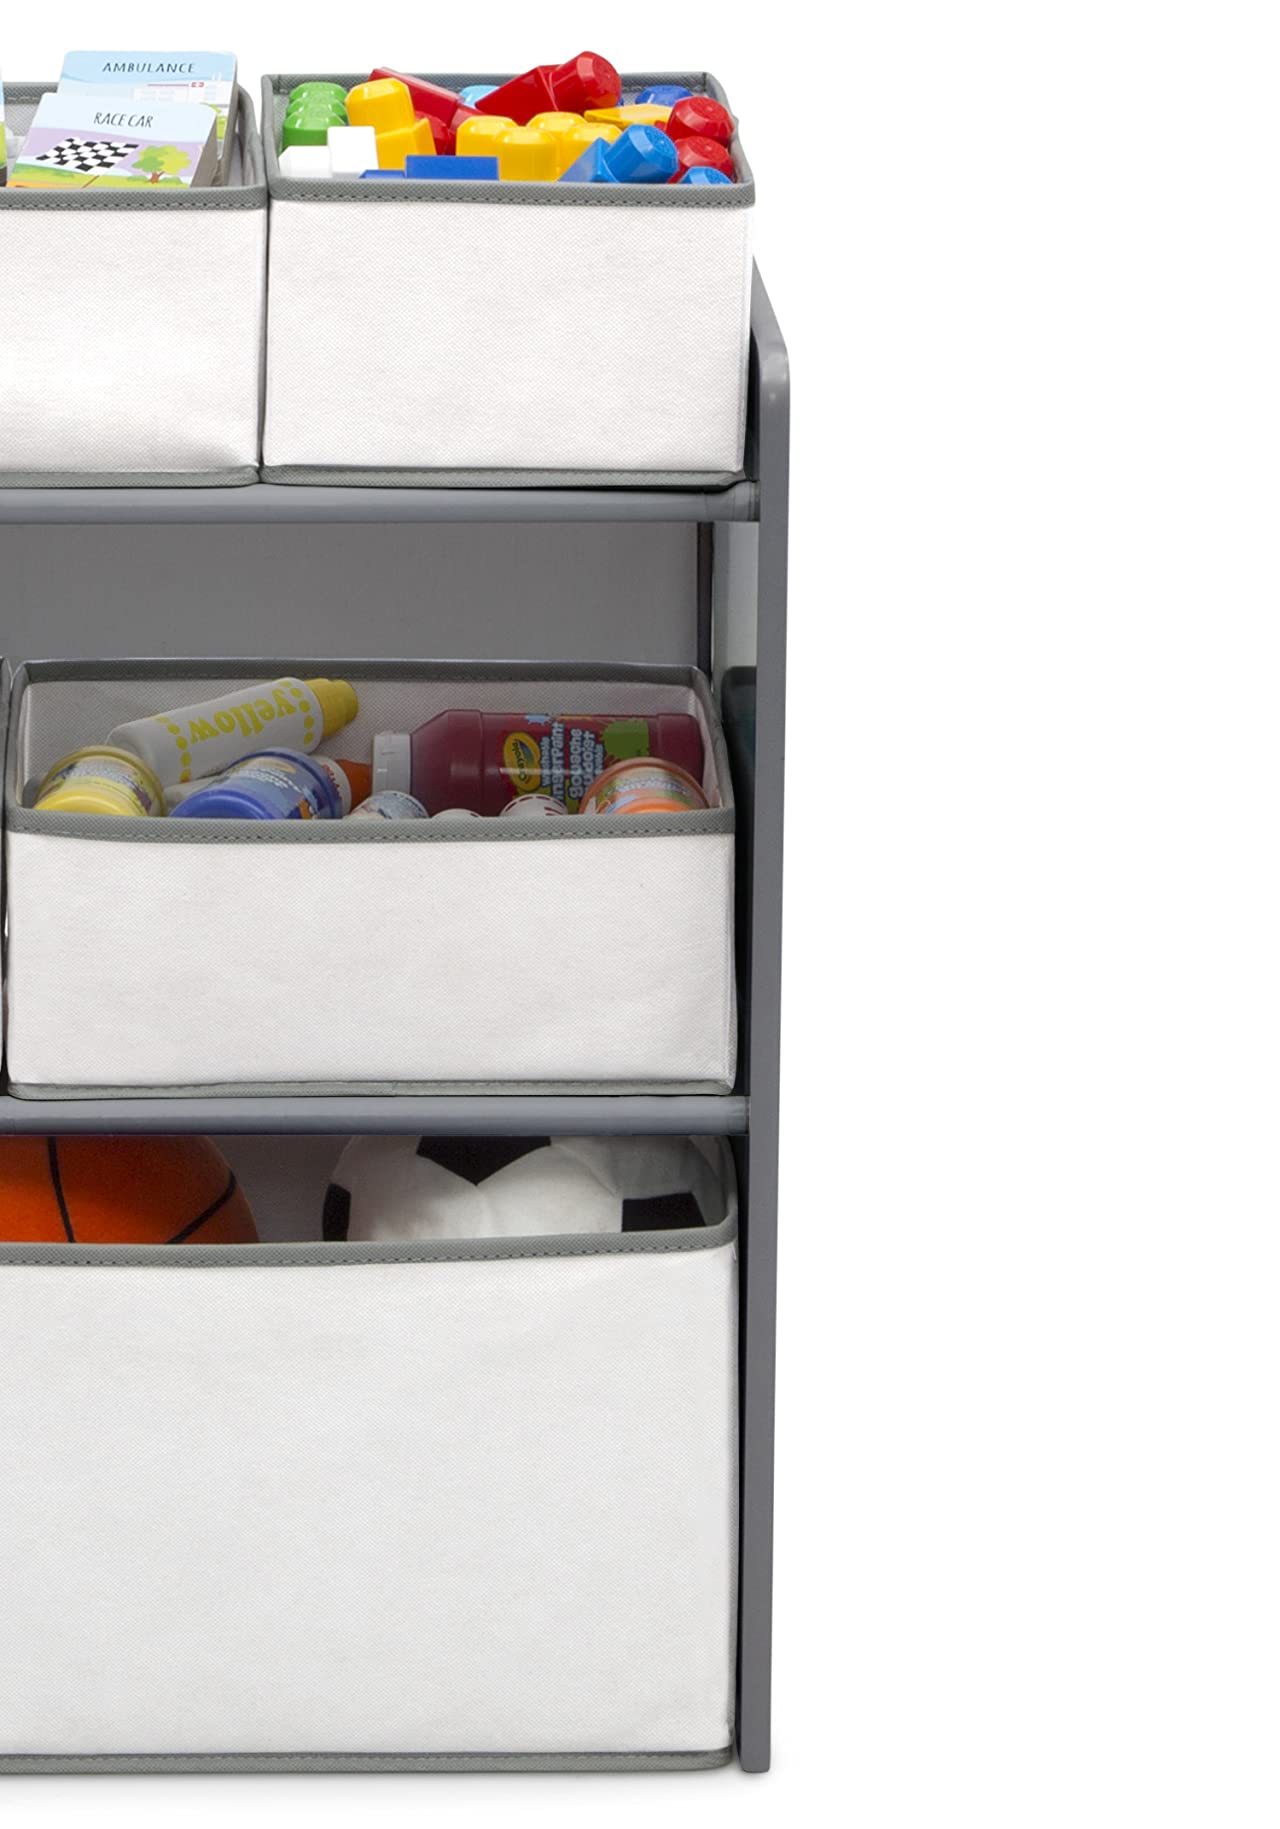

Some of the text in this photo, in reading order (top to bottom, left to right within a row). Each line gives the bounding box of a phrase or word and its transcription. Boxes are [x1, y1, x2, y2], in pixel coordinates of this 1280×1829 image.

[102, 61, 196, 74] AMBULANCE
[94, 112, 154, 128] RACE CAR
[188, 689, 297, 745] yellow
[511, 739, 528, 782] Crayola
[568, 728, 584, 799] gouache
